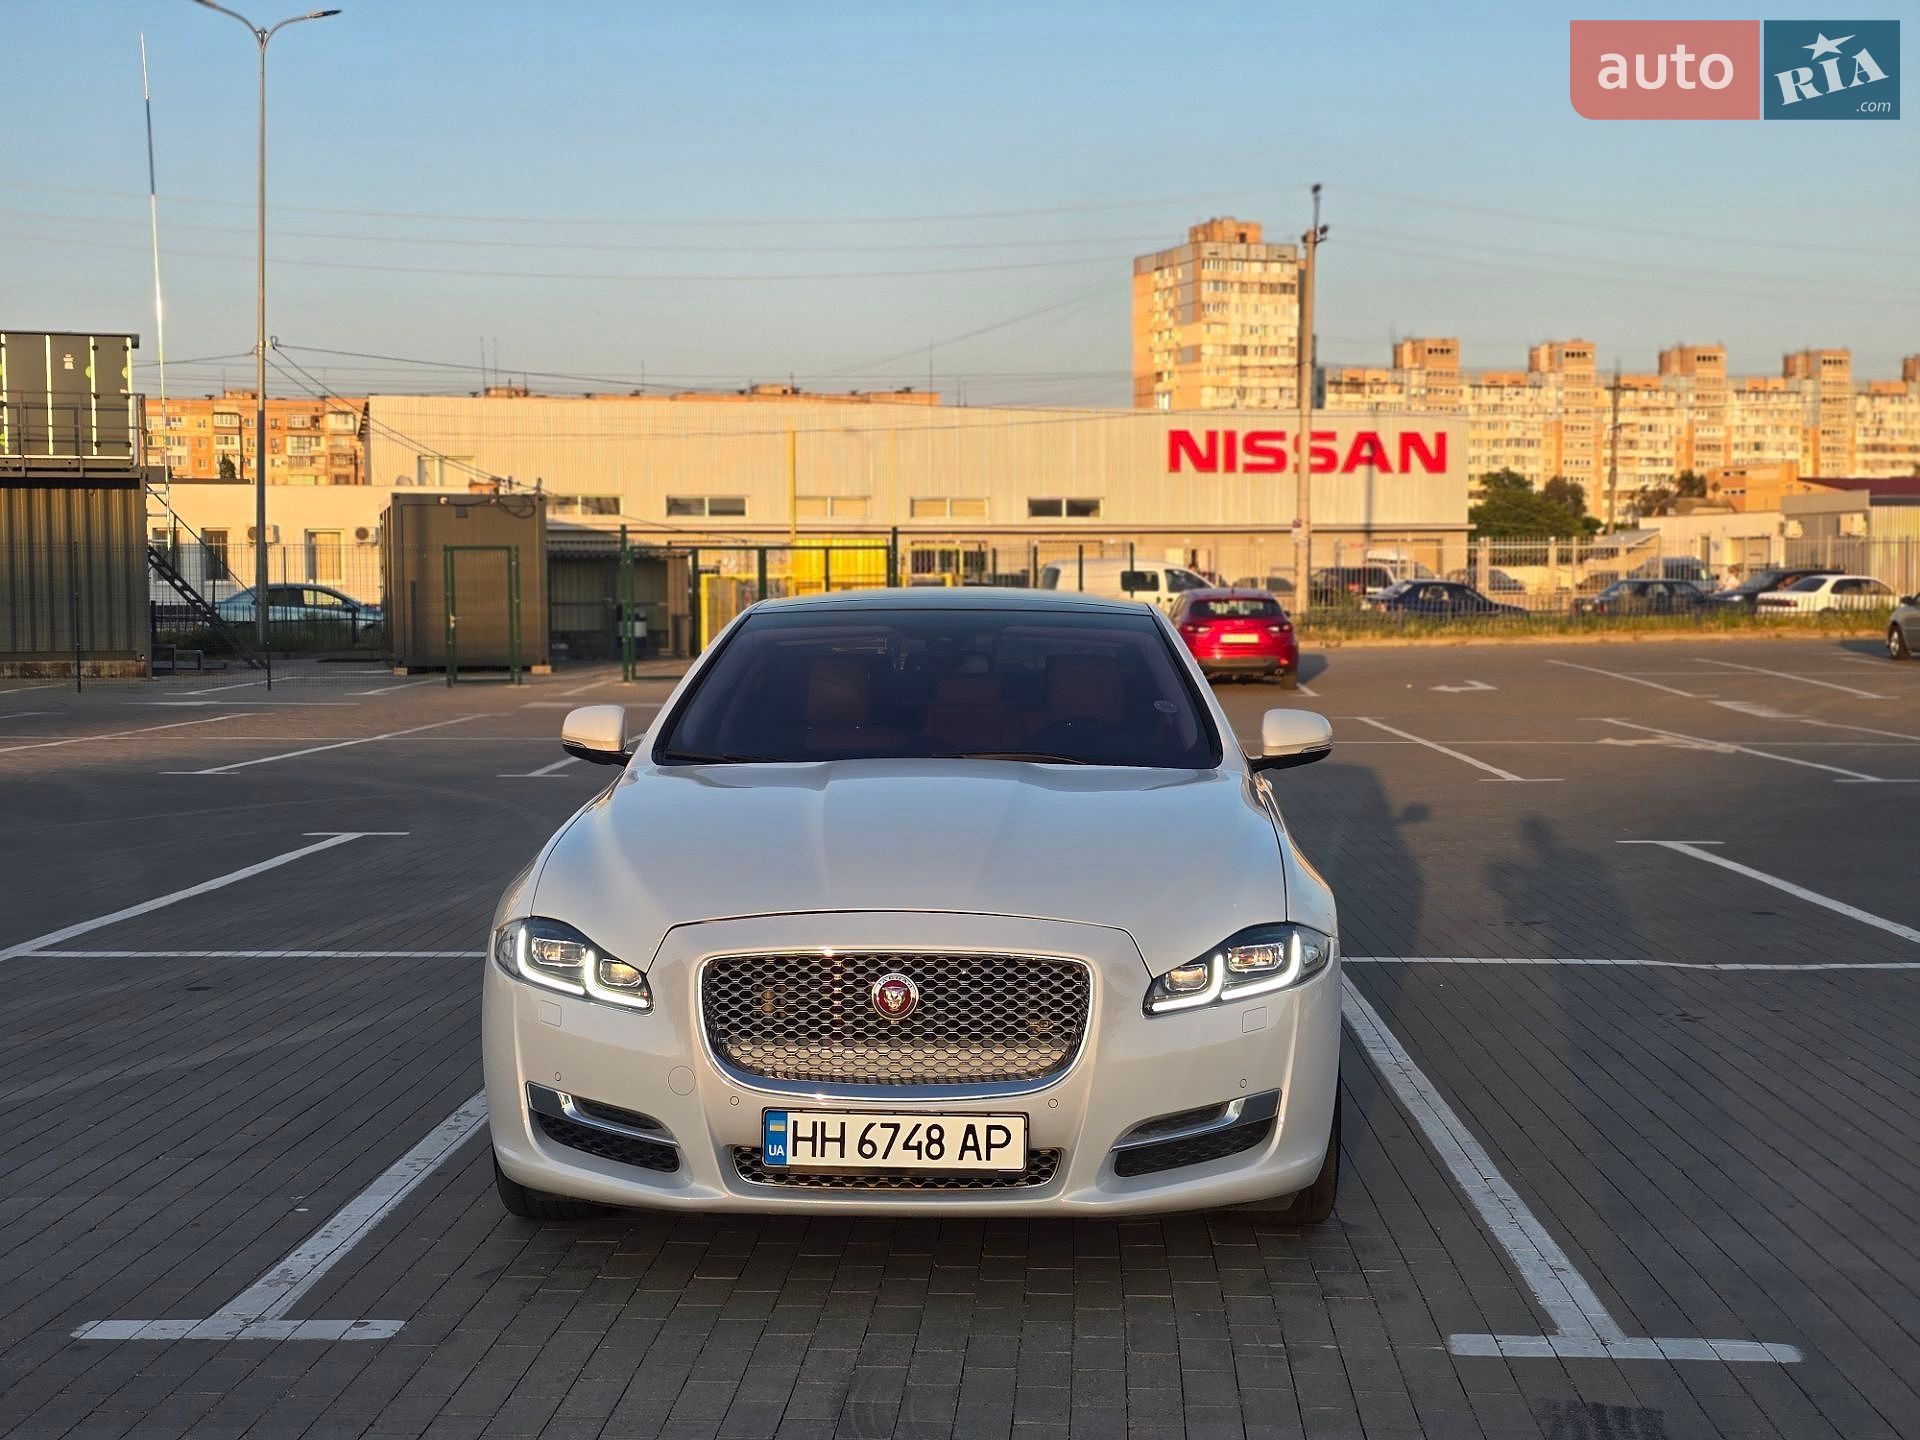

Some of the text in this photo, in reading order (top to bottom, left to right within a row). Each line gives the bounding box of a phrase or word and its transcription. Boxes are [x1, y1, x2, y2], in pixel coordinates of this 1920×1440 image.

[1168, 430, 1448, 474] NISSAN
[768, 1144, 786, 1157] UA
[791, 1120, 1013, 1161] HH 6748 AP
